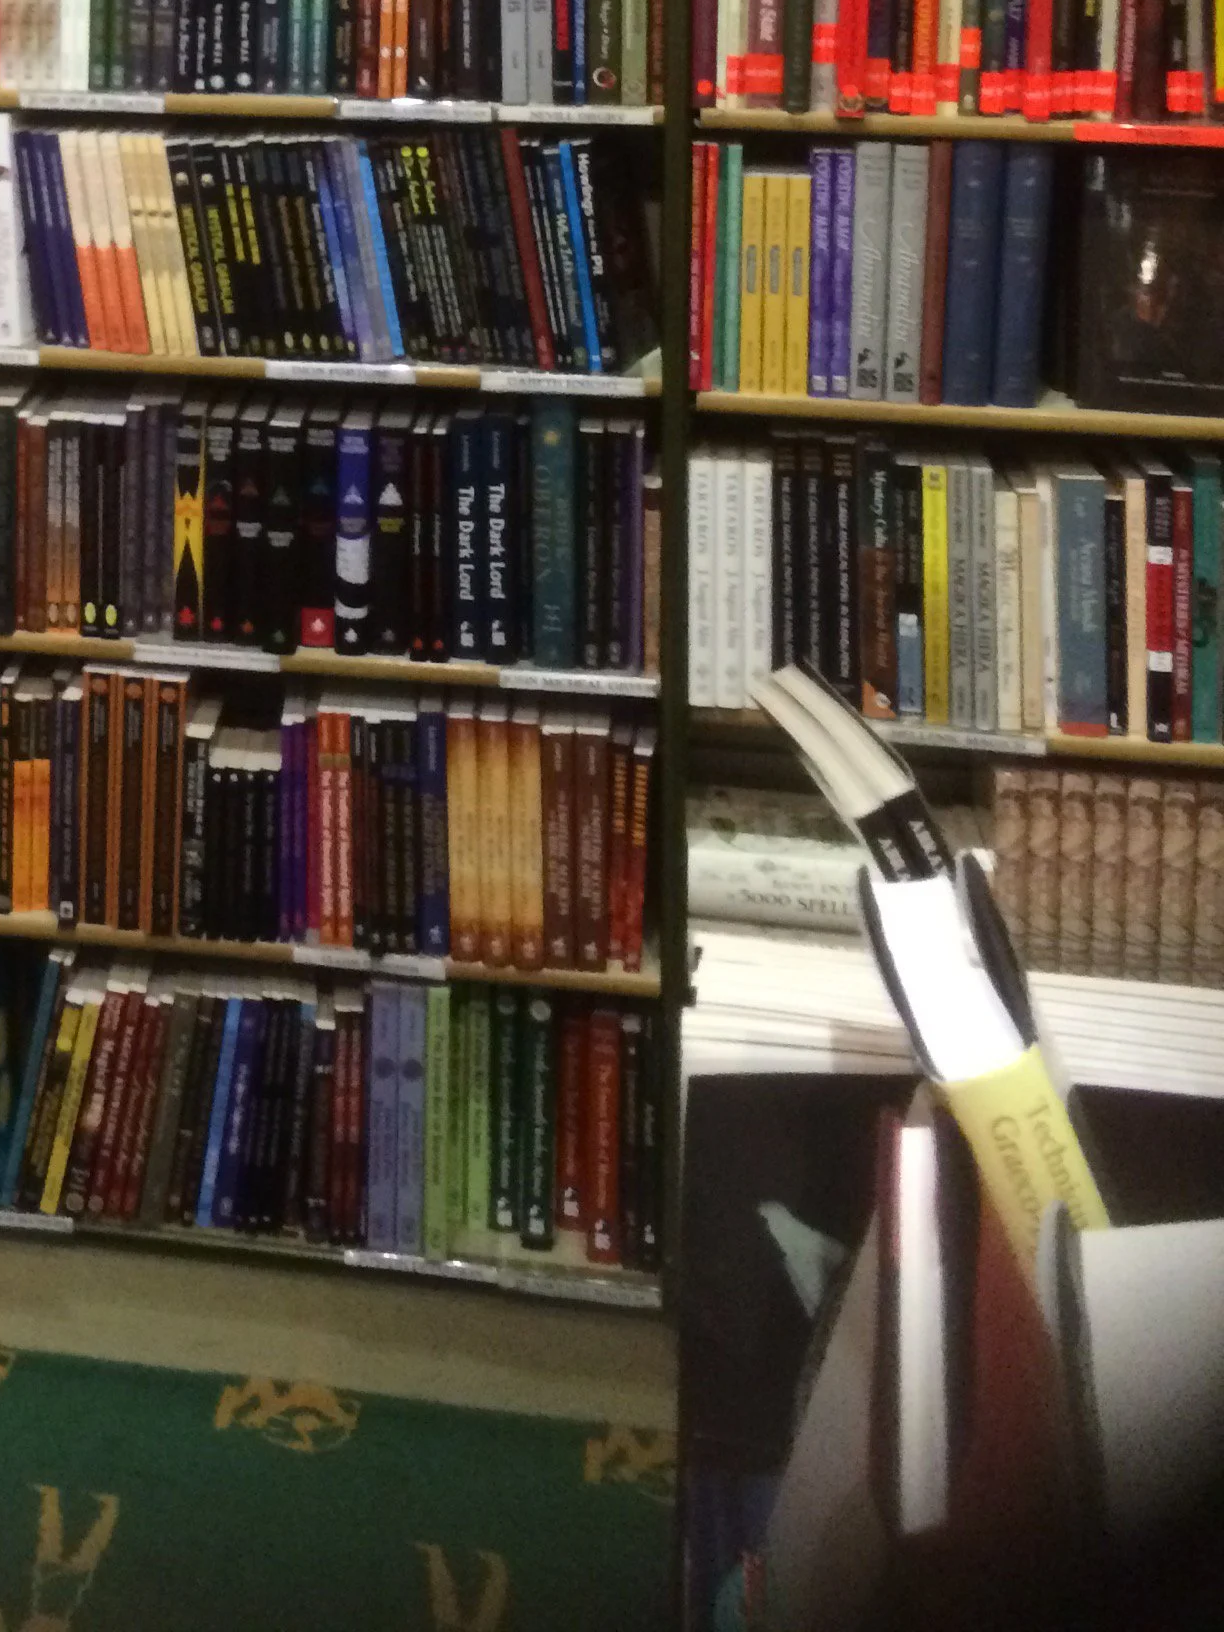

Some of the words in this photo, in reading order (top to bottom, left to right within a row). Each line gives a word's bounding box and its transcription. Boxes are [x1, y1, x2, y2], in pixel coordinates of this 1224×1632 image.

[857, 218, 880, 339] Abramelin
[893, 222, 919, 342] Abramelin
[458, 486, 475, 516] The
[488, 483, 505, 513] The
[458, 520, 475, 559] Dark
[488, 518, 504, 556] Dark
[459, 564, 475, 600] Lord
[488, 562, 505, 599] Lord
